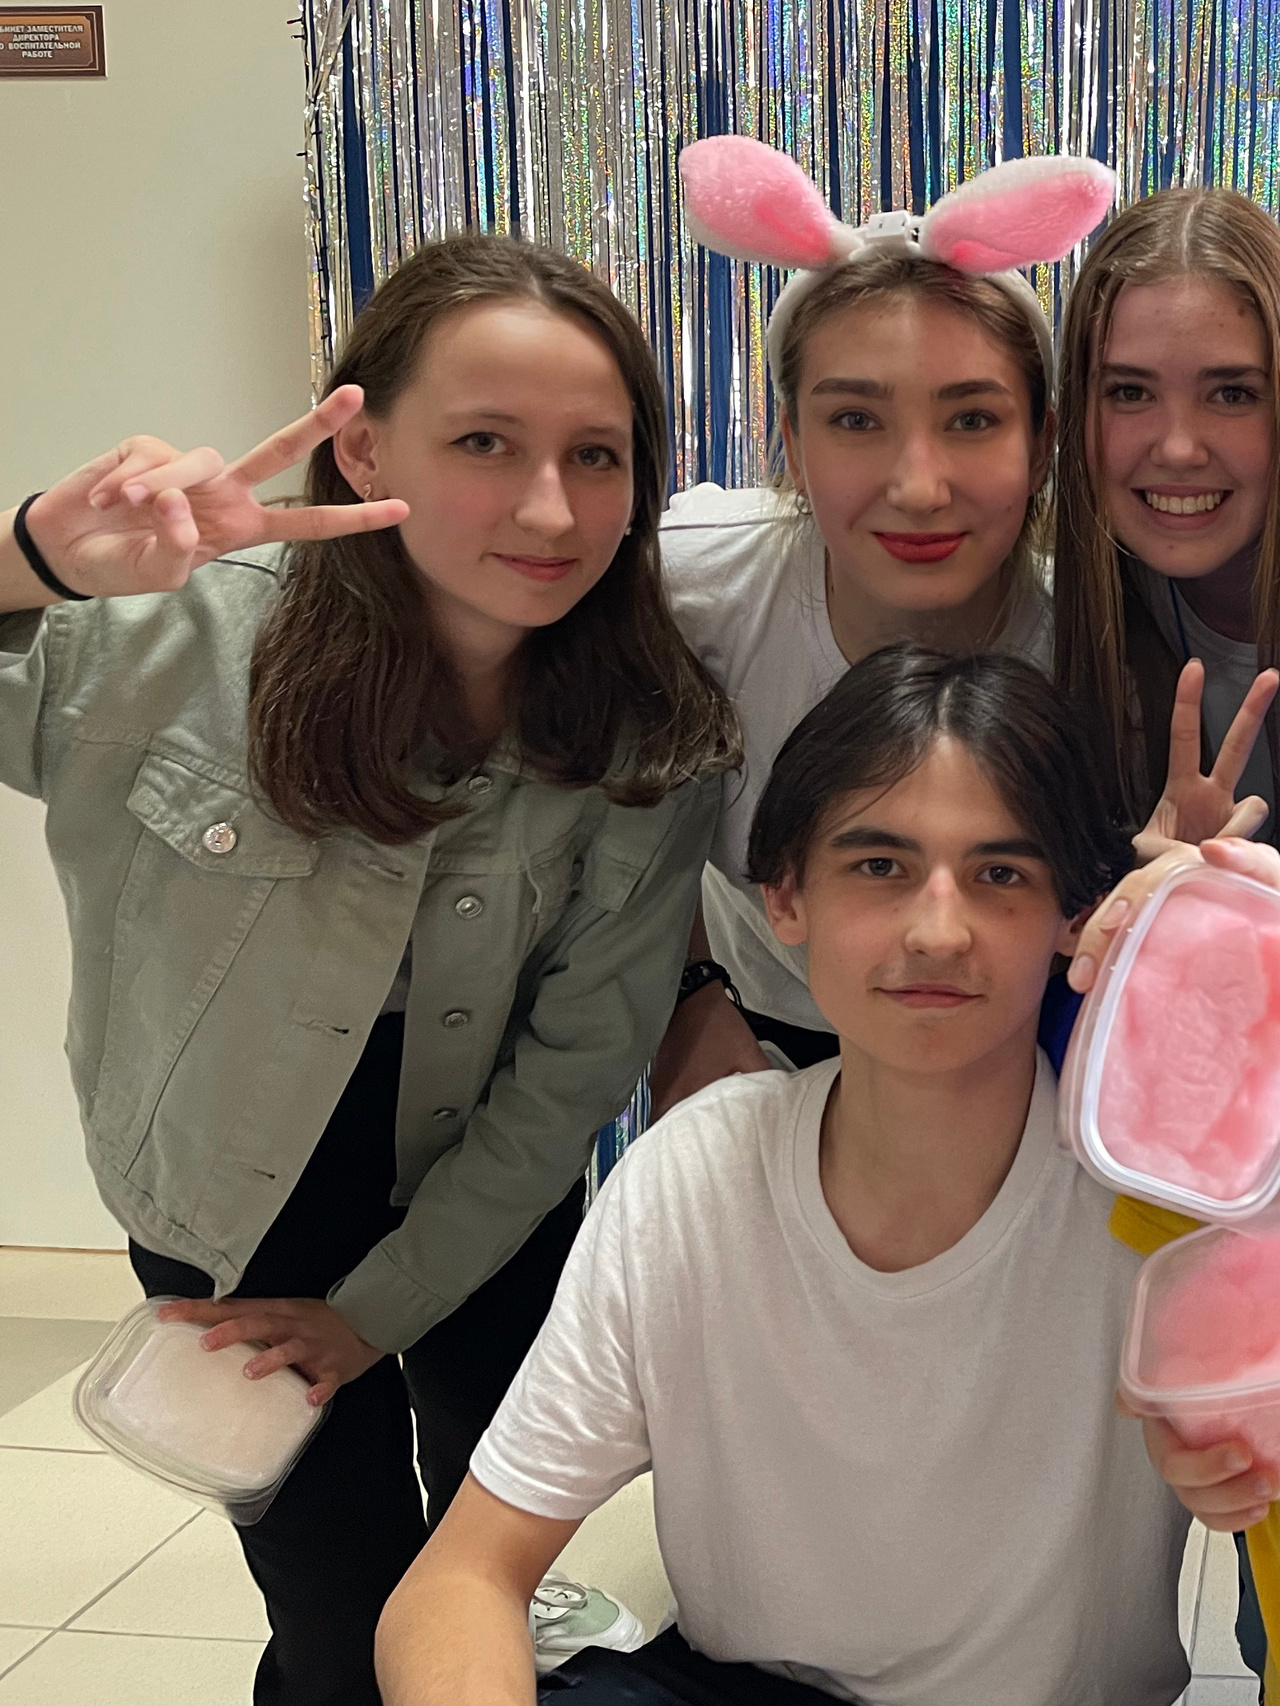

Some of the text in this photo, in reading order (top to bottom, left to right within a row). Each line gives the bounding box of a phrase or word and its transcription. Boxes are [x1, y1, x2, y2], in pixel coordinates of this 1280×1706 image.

[27, 25, 83, 33] ЗАМЕСТИТЕЛЯ
[13, 34, 59, 42] ДИРЕКТОРА
[8, 41, 81, 50] ВОСПИТАТЕЛЬНОЙ
